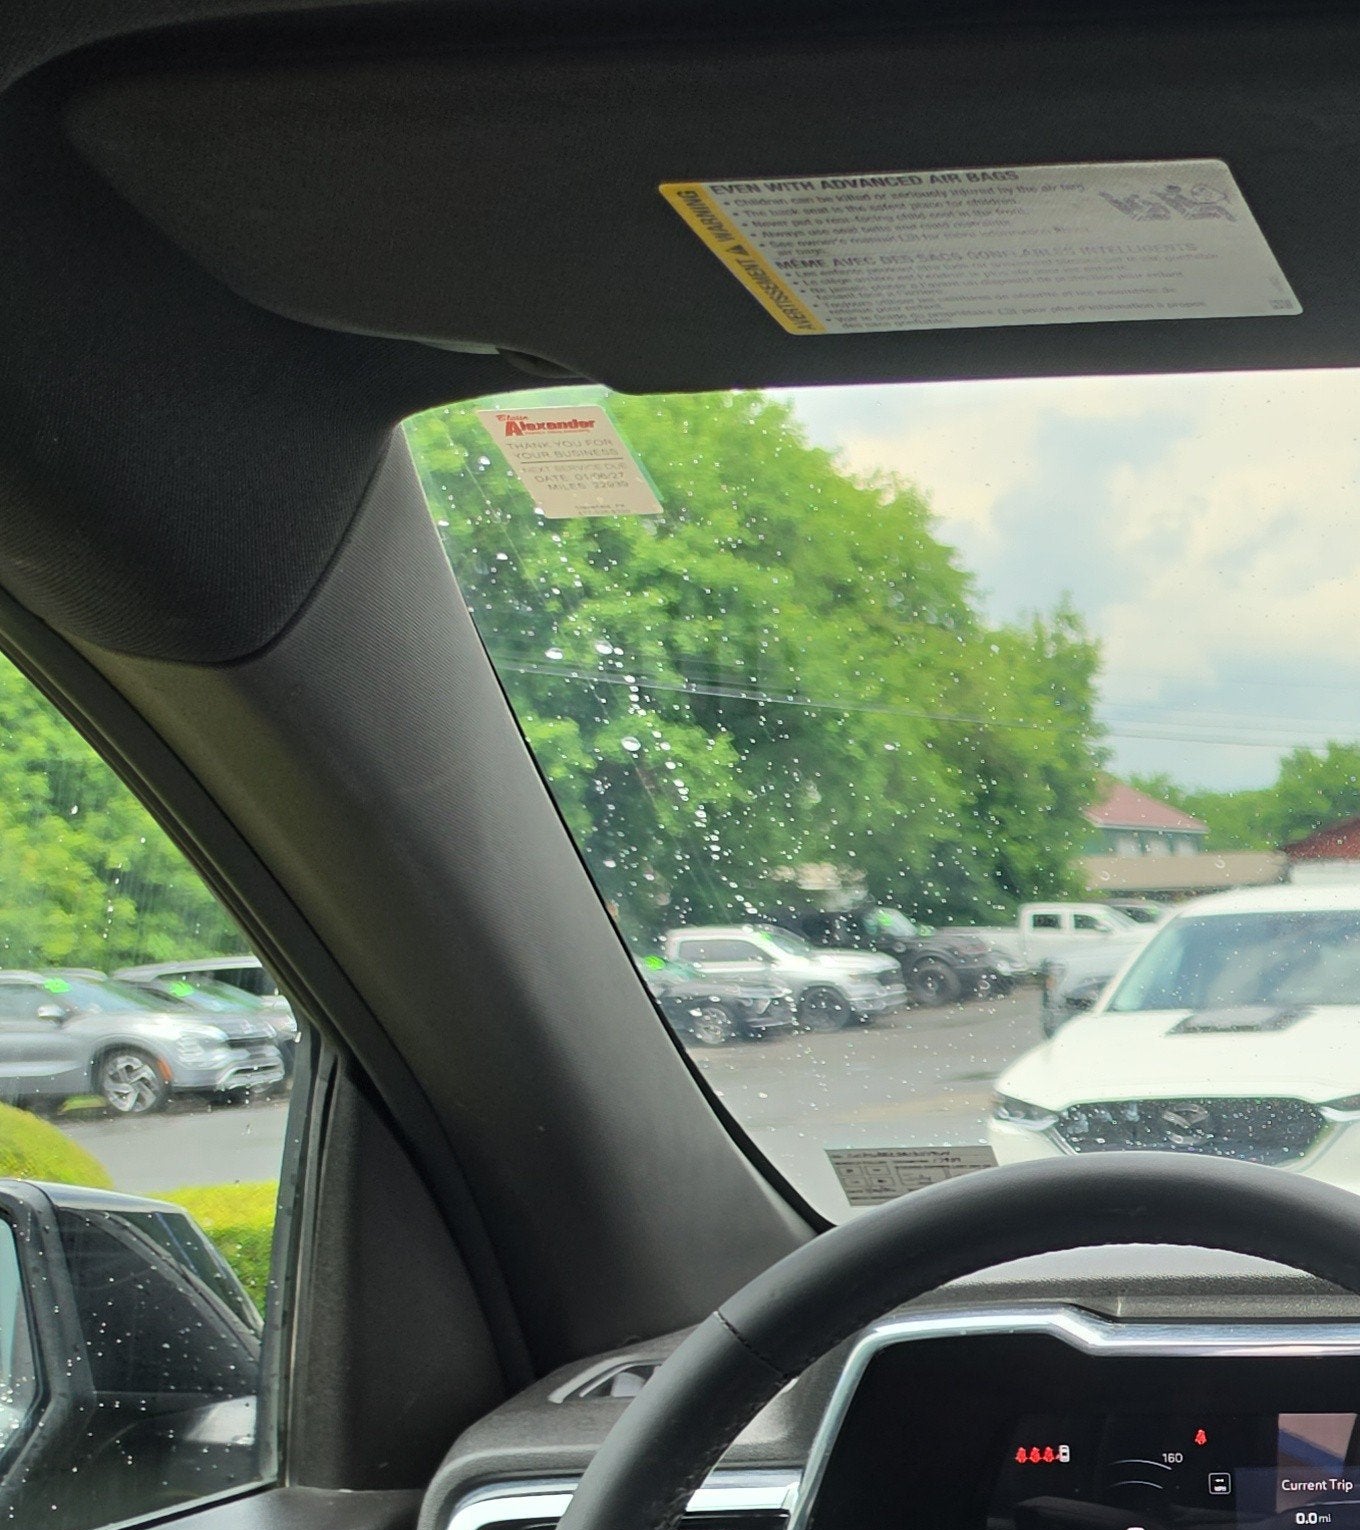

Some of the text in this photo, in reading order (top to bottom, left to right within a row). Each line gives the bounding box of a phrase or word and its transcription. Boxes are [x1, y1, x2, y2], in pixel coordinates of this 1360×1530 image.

[710, 171, 1019, 195] EVEN WITH ADVANCED AIR BAGS
[676, 189, 736, 243] WARNING
[774, 257, 826, 270] MÊME
[833, 255, 875, 268] AVEC
[505, 418, 595, 437] Alexander
[506, 441, 549, 451] THANK
[554, 439, 583, 449] YOU
[514, 448, 619, 460] YOUR BUSINESS
[534, 474, 568, 483] DATE
[547, 481, 587, 491] MILES
[1161, 1452, 1184, 1464] 160
[1281, 1478, 1354, 1493] Current Trip
[1295, 1512, 1332, 1525] 0.0 mi
